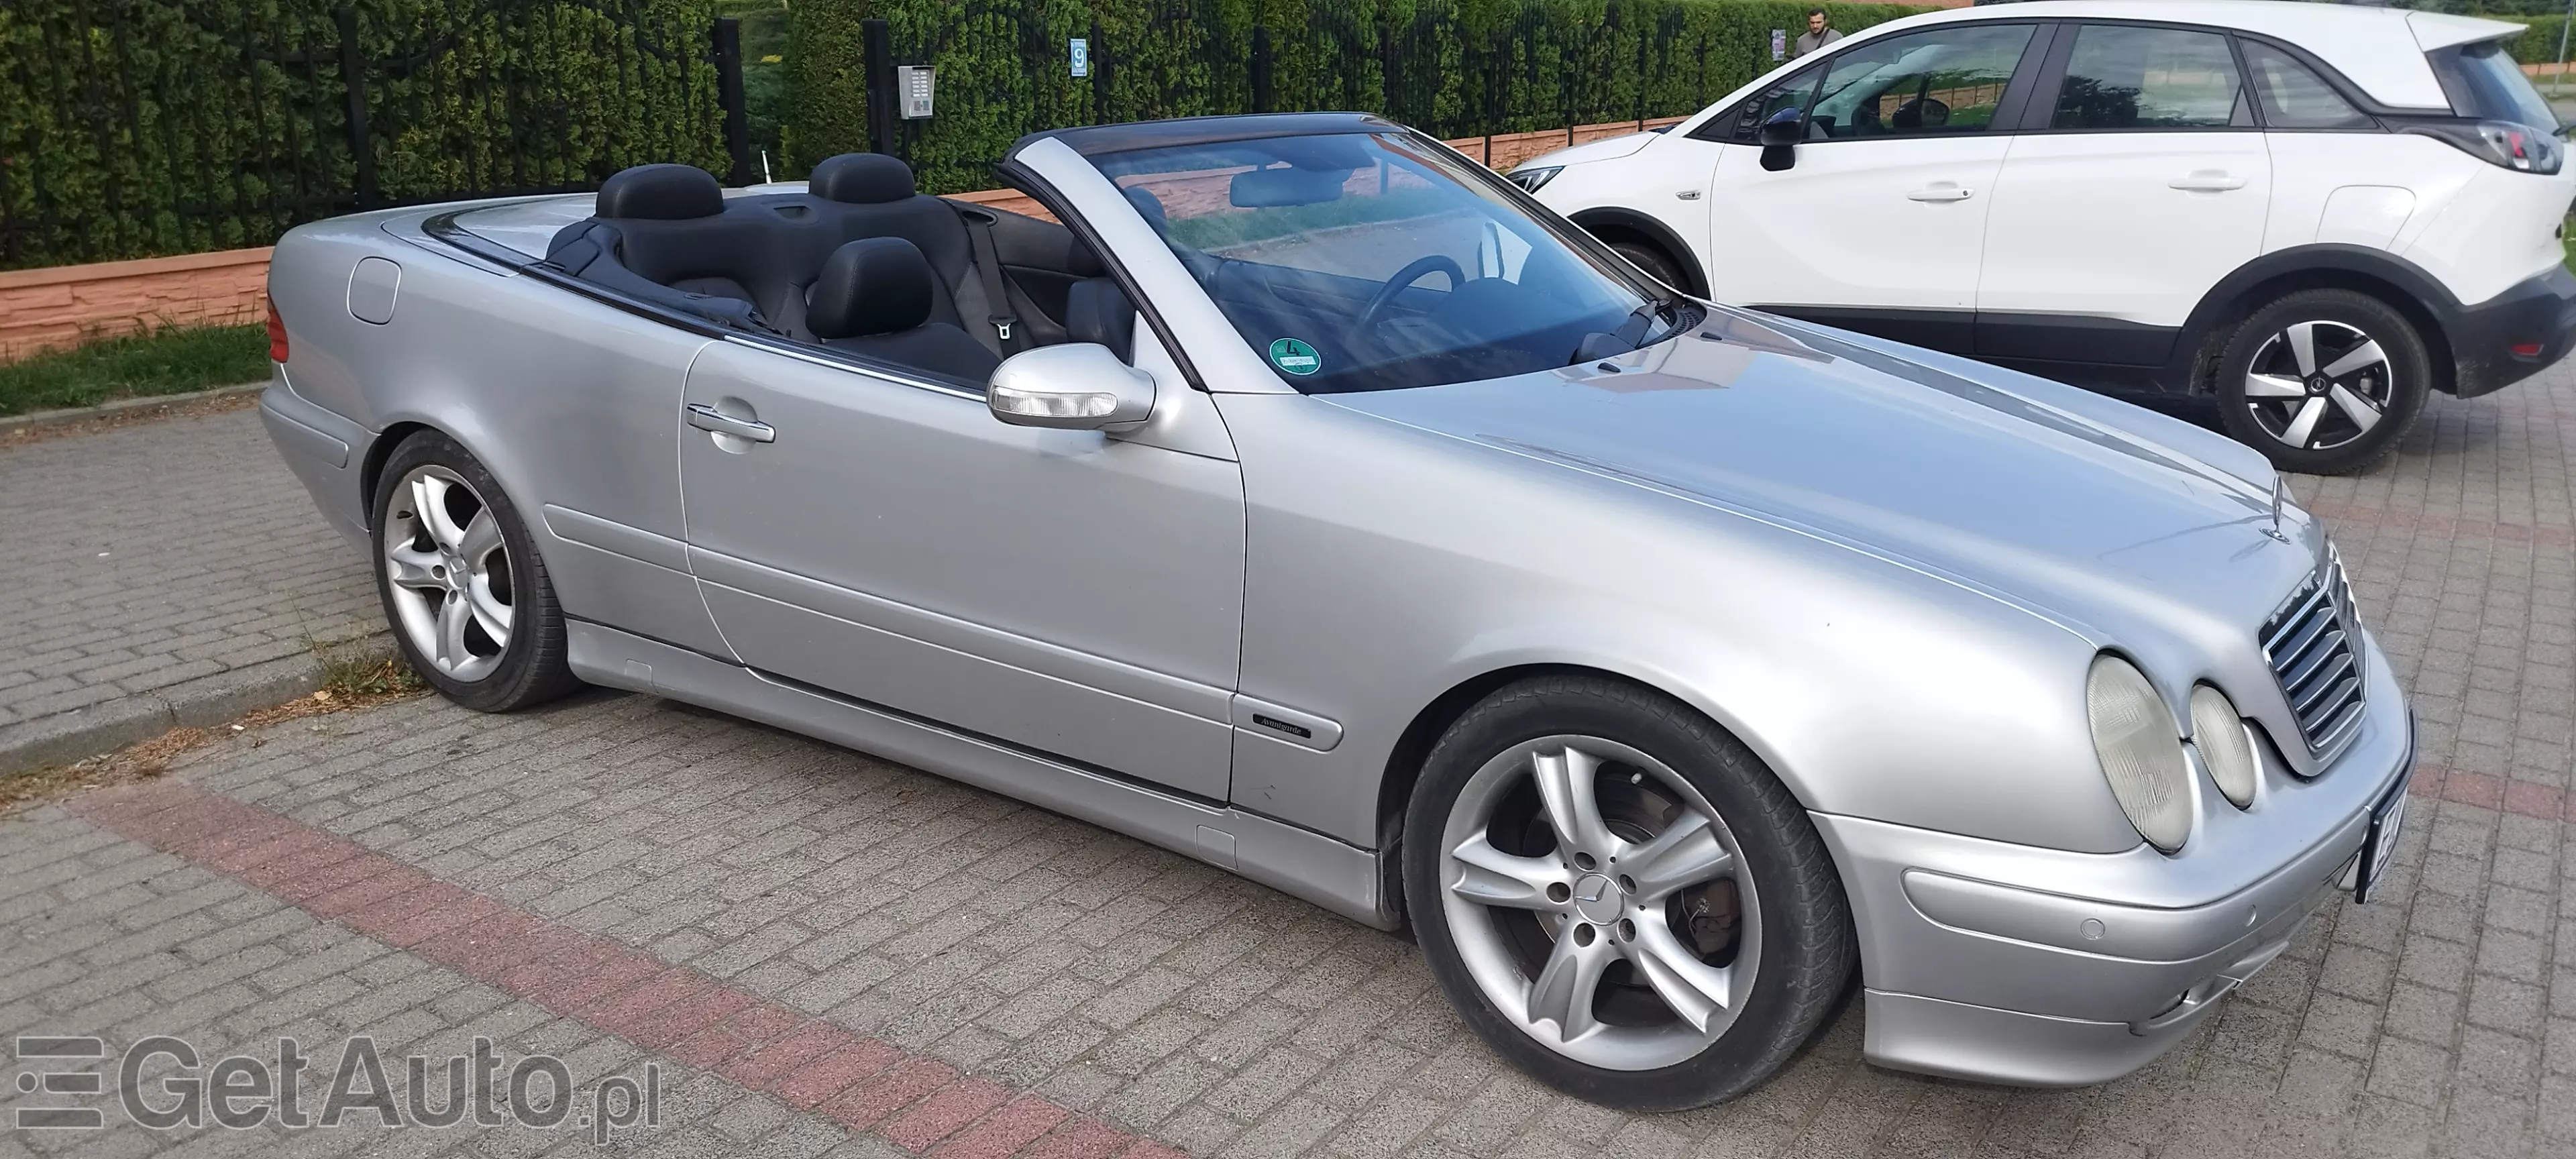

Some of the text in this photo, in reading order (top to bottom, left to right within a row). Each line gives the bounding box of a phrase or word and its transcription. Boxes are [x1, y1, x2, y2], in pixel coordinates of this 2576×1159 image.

[1074, 48, 1084, 68] 9
[1287, 341, 1300, 355] 4
[1261, 718, 1301, 734] Avantgarde
